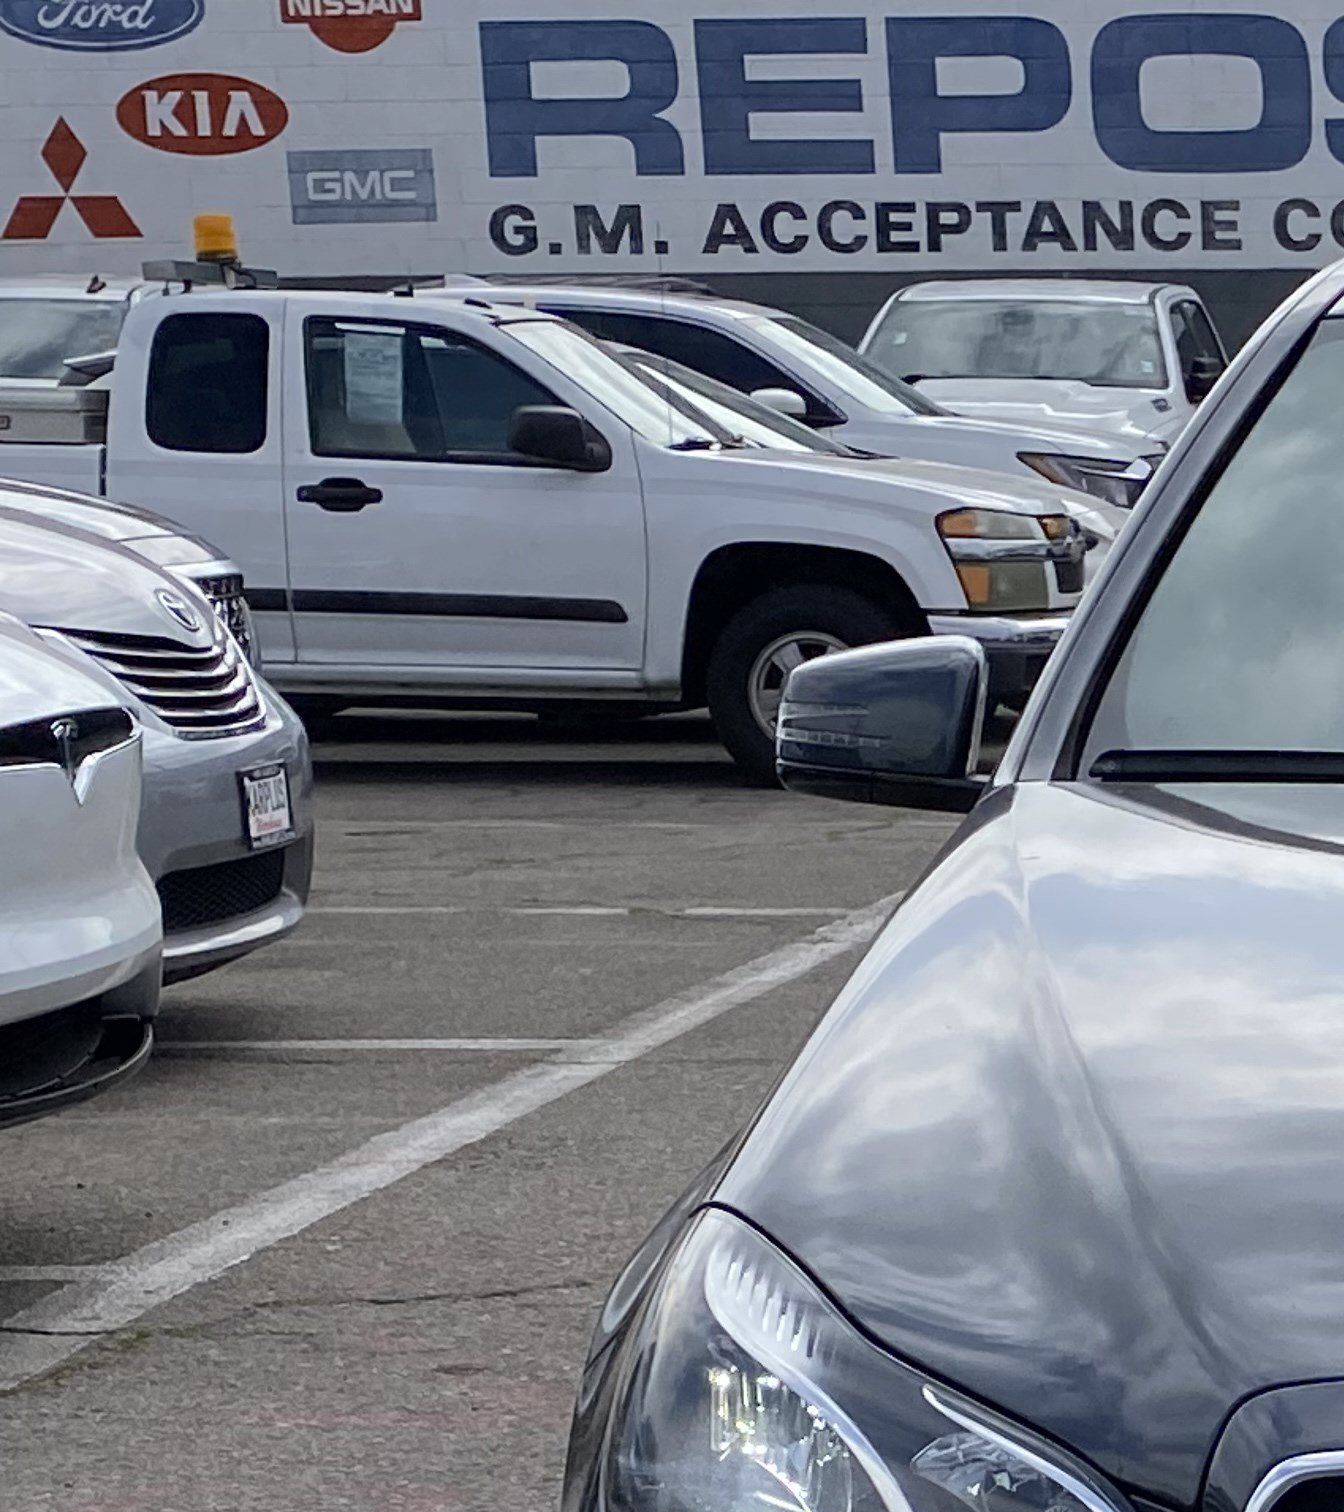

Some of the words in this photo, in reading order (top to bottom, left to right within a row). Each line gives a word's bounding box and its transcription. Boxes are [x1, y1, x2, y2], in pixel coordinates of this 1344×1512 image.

[289, 0, 414, 16] NISSAN
[141, 90, 266, 137] KIA
[306, 170, 417, 201] GMC
[488, 204, 670, 256] G.M.
[702, 199, 1244, 255] ACCEPTANCE
